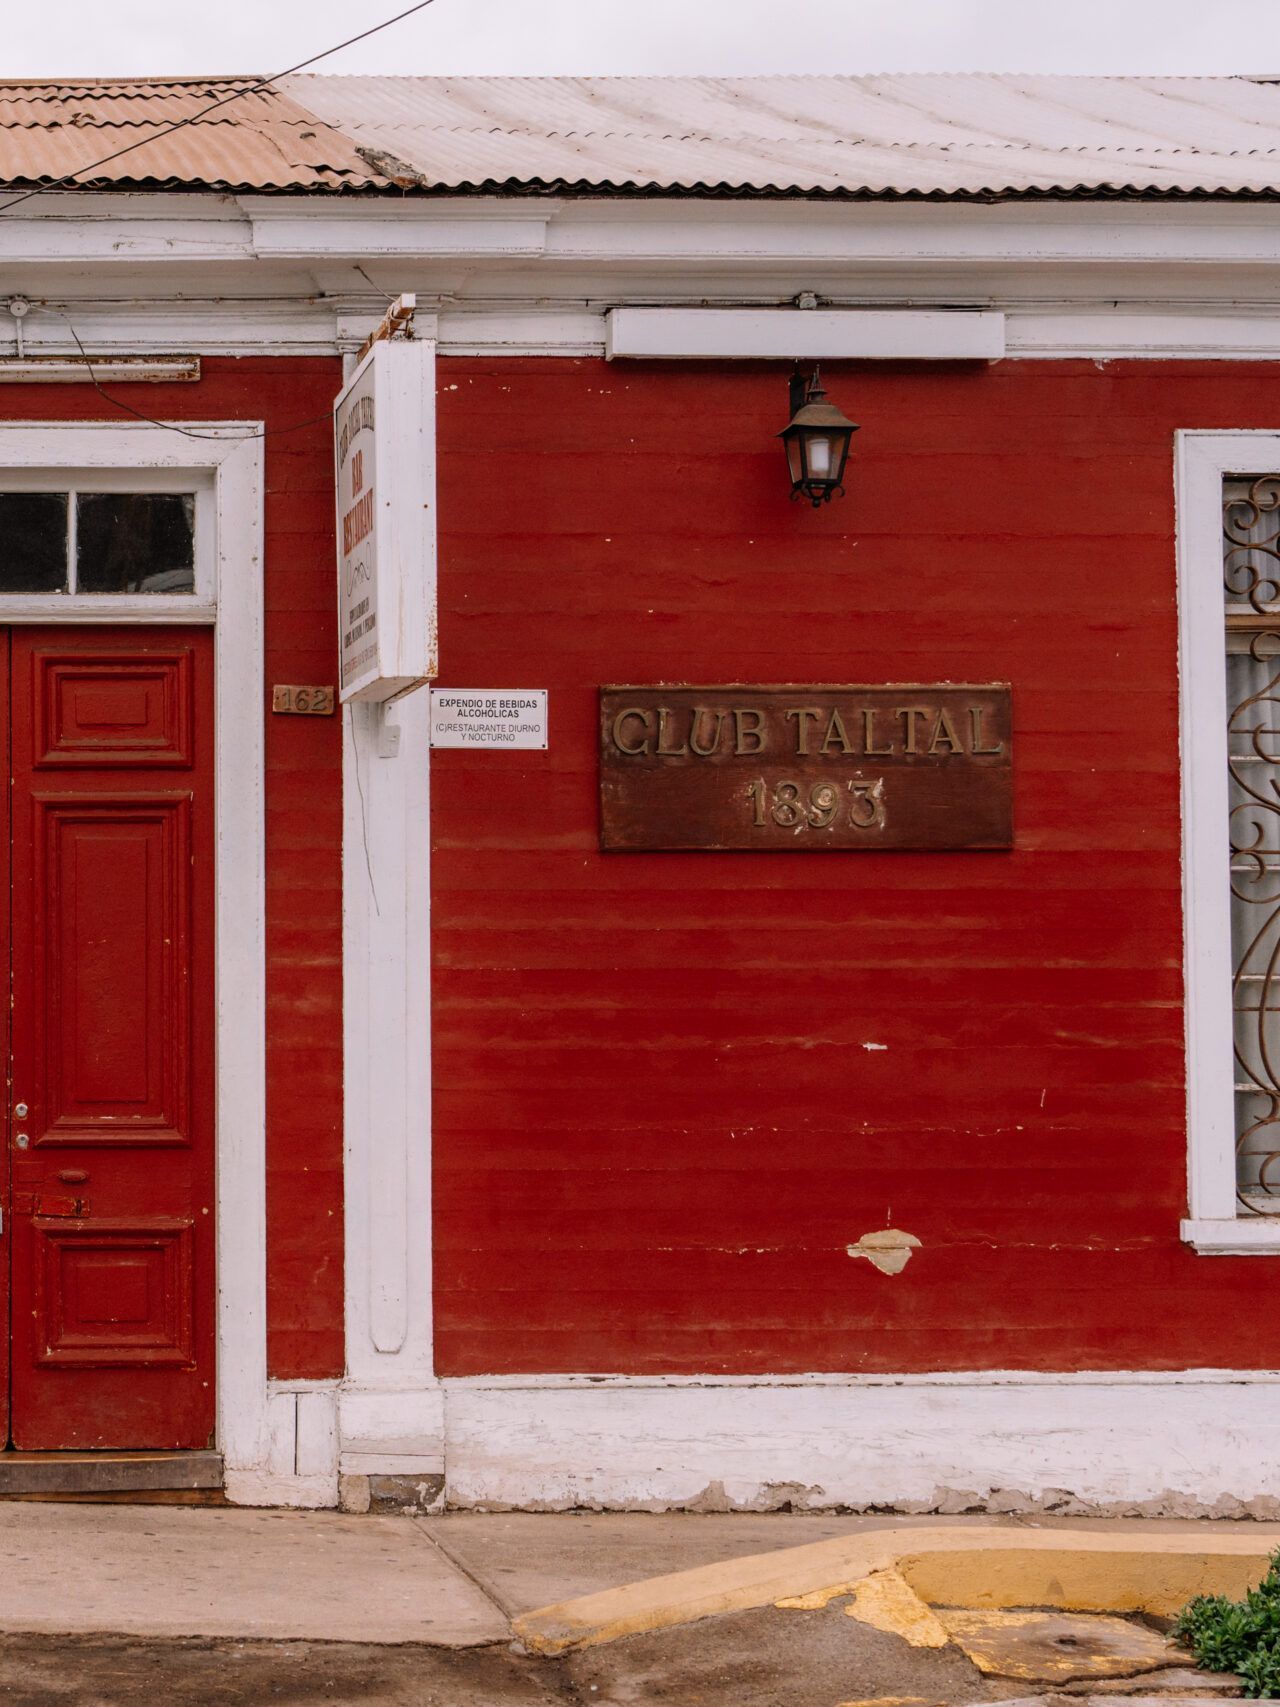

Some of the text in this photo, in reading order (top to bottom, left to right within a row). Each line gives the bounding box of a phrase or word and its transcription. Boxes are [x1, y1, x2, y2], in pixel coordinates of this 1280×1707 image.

[352, 449, 362, 498] BAR
[344, 487, 373, 558] RESTAURANT
[282, 688, 328, 711] 162
[439, 699, 538, 709] EXPENDIO DE BEBIDAS
[457, 708, 519, 718] ALCOHÓLICAS
[461, 733, 516, 742] Y NOCTURNO
[508, 724, 541, 733] DIURNO
[612, 706, 1005, 757] CLUB TALTAL
[747, 779, 880, 828] 1893
